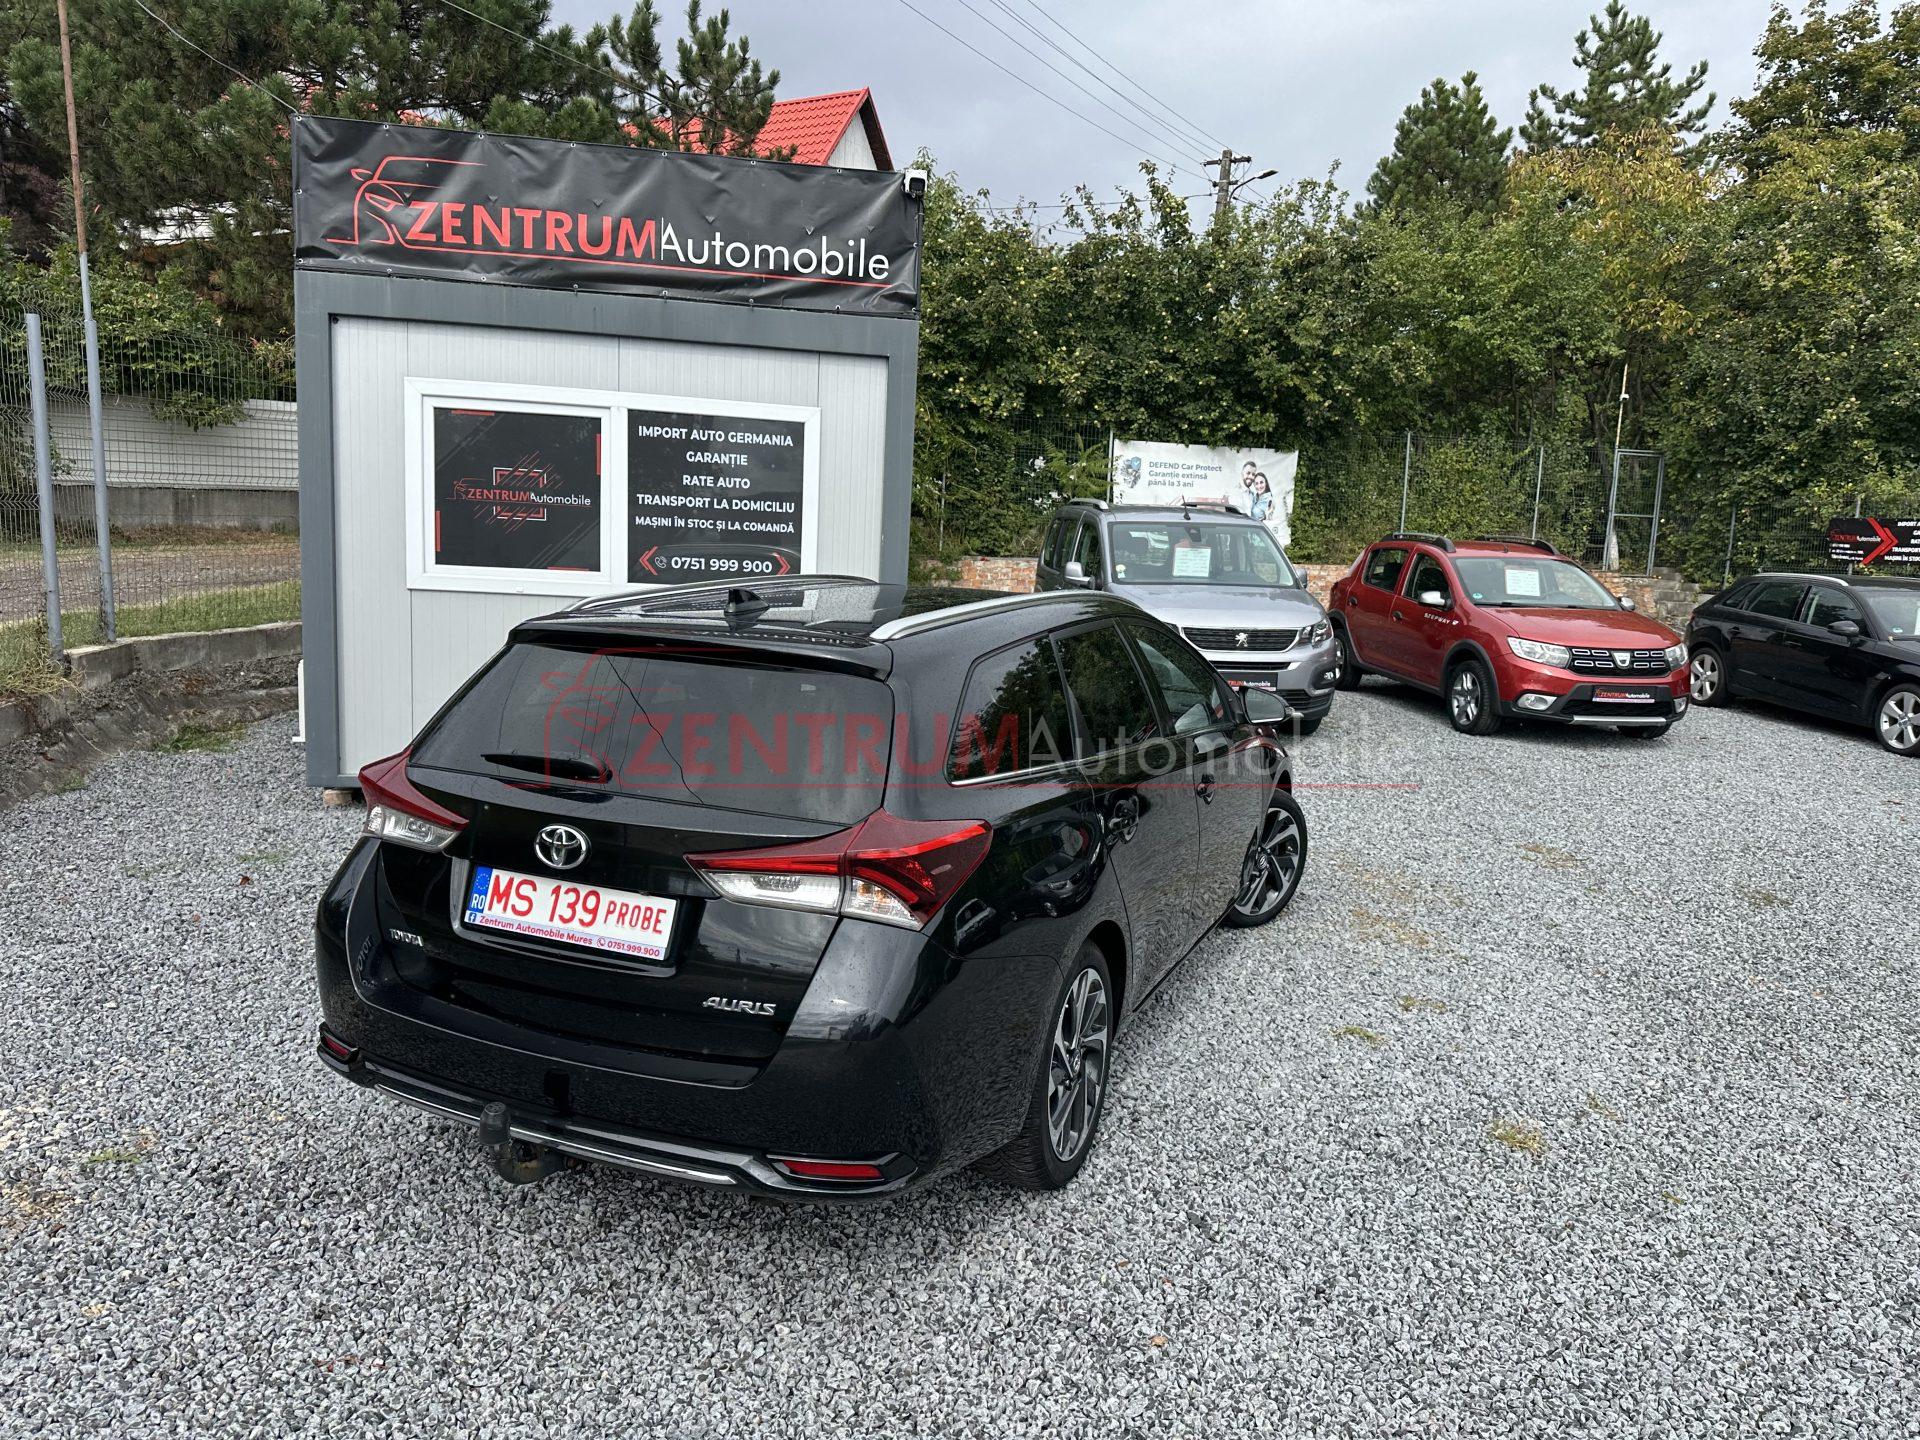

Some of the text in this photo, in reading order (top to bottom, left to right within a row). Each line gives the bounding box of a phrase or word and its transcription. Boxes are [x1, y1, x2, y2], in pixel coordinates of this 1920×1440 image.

[405, 201, 891, 281] ZENTRUM Automobile
[638, 425, 793, 447] IMPORT AUTO GERMANIA
[686, 451, 748, 468] GARANȚIE
[1149, 461, 1180, 470] DEFEND
[1196, 464, 1222, 472] Protect
[683, 475, 751, 489] RATE AUTO
[1168, 479, 1175, 487] la
[1182, 480, 1194, 488] ani
[468, 488, 591, 506] ZENTRUM Automobile
[637, 493, 795, 513] TRANSPORT LA DOMICILIU
[635, 515, 795, 534] MAȘINI ÎN STOC ȘI LA COMANDĂ
[671, 557, 773, 573] 0751 999 900
[471, 894, 486, 911] RO
[487, 874, 667, 935] MS 139 PROBE
[389, 928, 425, 947] TOYOTA
[479, 915, 661, 957] Zentrum Automobile Mures 0751.999.900
[703, 996, 777, 1016] AURIS
